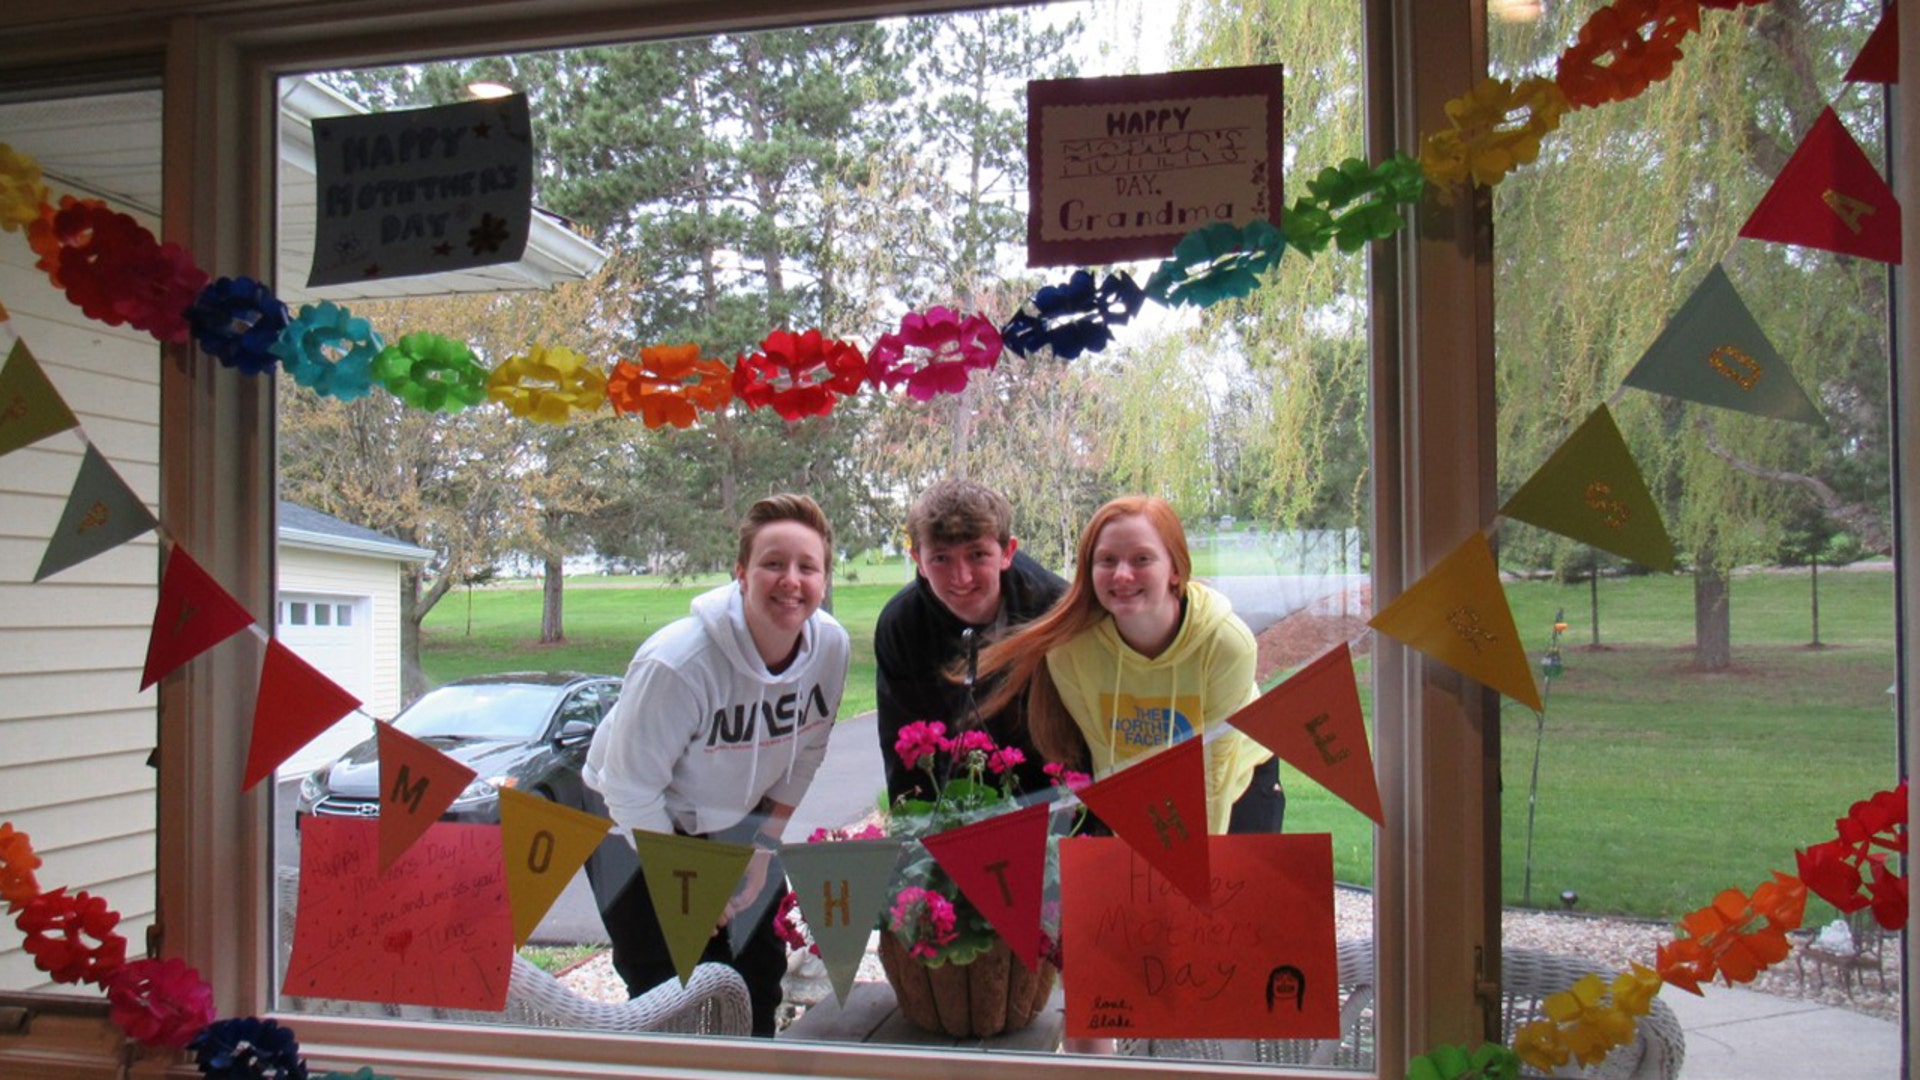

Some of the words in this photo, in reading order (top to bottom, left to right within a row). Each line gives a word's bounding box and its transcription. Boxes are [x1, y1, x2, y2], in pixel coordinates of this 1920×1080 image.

[1106, 106, 1191, 137] HAPPY
[341, 126, 468, 174] HAPPY
[380, 211, 452, 247] DAY
[1058, 197, 1234, 232] Grandma
[1821, 188, 1877, 237] A
[1584, 481, 1632, 528] S
[706, 682, 830, 747] NASA
[1108, 718, 1162, 733] NORTH
[1133, 705, 1161, 720] THE
[1124, 730, 1162, 746] FACE
[389, 764, 432, 815] M
[672, 869, 698, 915] T
[822, 879, 851, 928] H
[984, 859, 1013, 908] T
[1146, 794, 1191, 849] H
[1303, 712, 1351, 768] E
[1141, 953, 1238, 1001] Day
